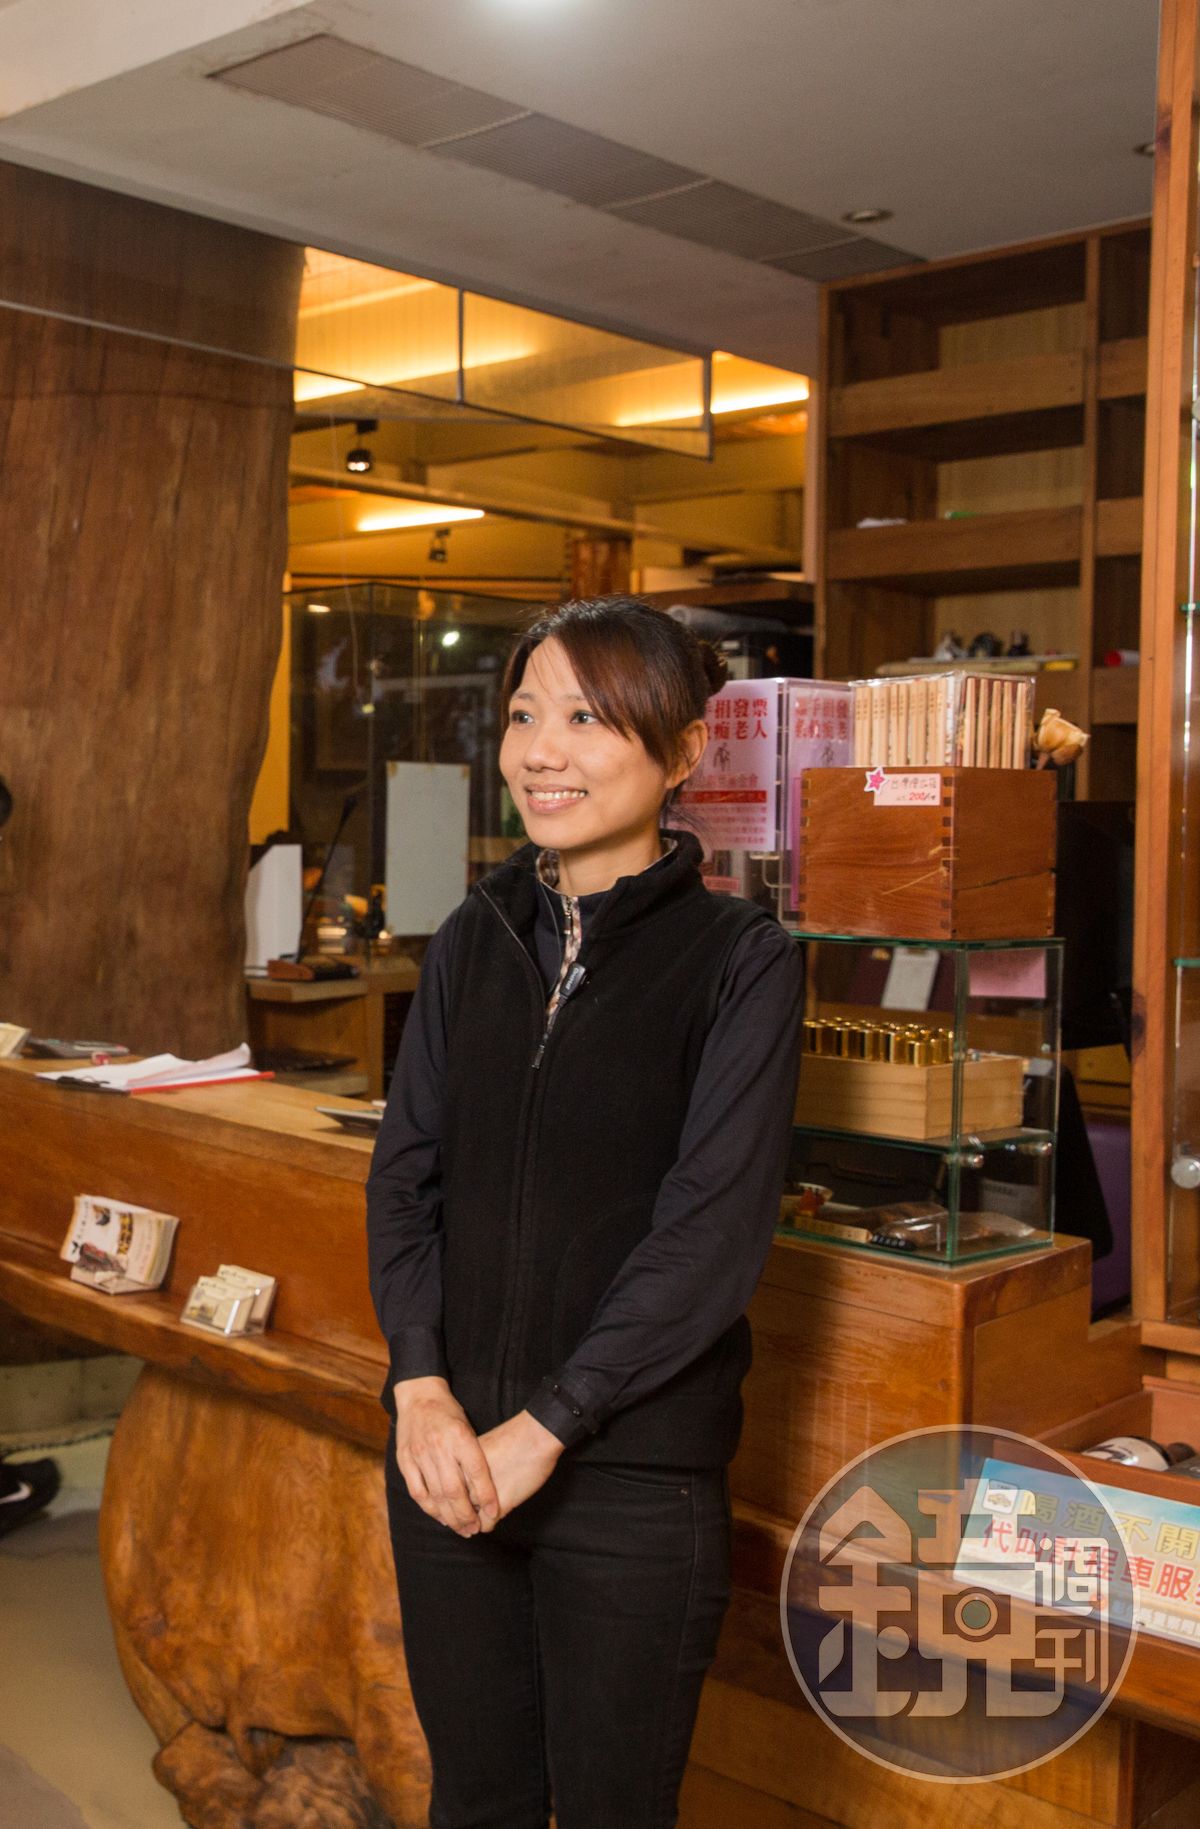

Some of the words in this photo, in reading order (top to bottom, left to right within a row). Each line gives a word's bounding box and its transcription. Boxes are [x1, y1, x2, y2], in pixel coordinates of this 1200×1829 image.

[706, 698, 768, 719] 捐發票
[705, 720, 768, 741] 痴老人
[983, 1518, 1200, 1605] 代叫計程車服
